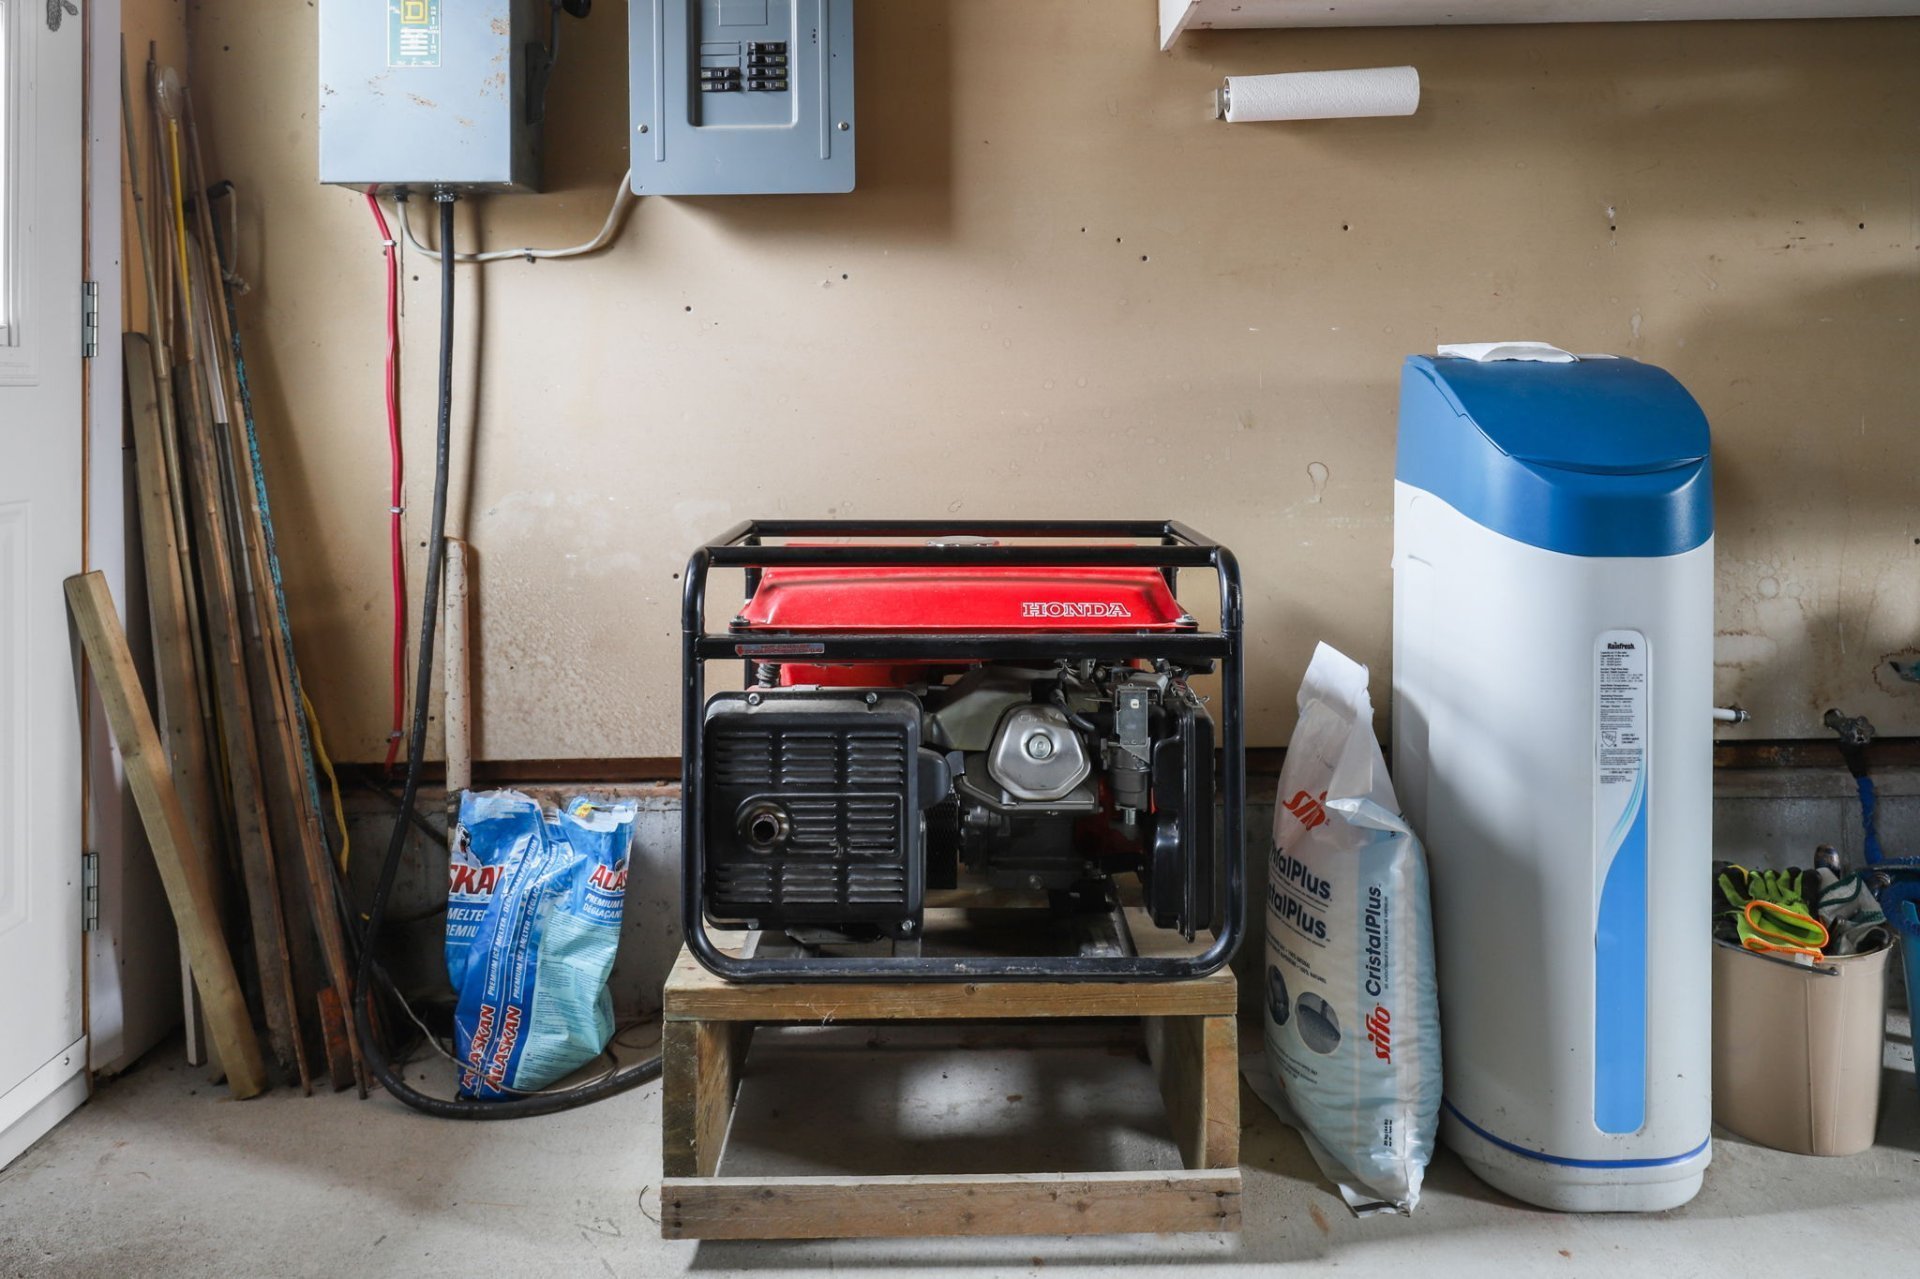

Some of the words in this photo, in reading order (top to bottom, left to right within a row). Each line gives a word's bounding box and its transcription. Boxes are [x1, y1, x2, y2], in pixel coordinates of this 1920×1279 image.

[1022, 602, 1131, 617] HONDA
[585, 892, 620, 909] PREMIUM
[583, 903, 623, 919] DÉGLAÇAN
[1365, 886, 1381, 997] CristalPlus
[1366, 1005, 1391, 1065] sifto
